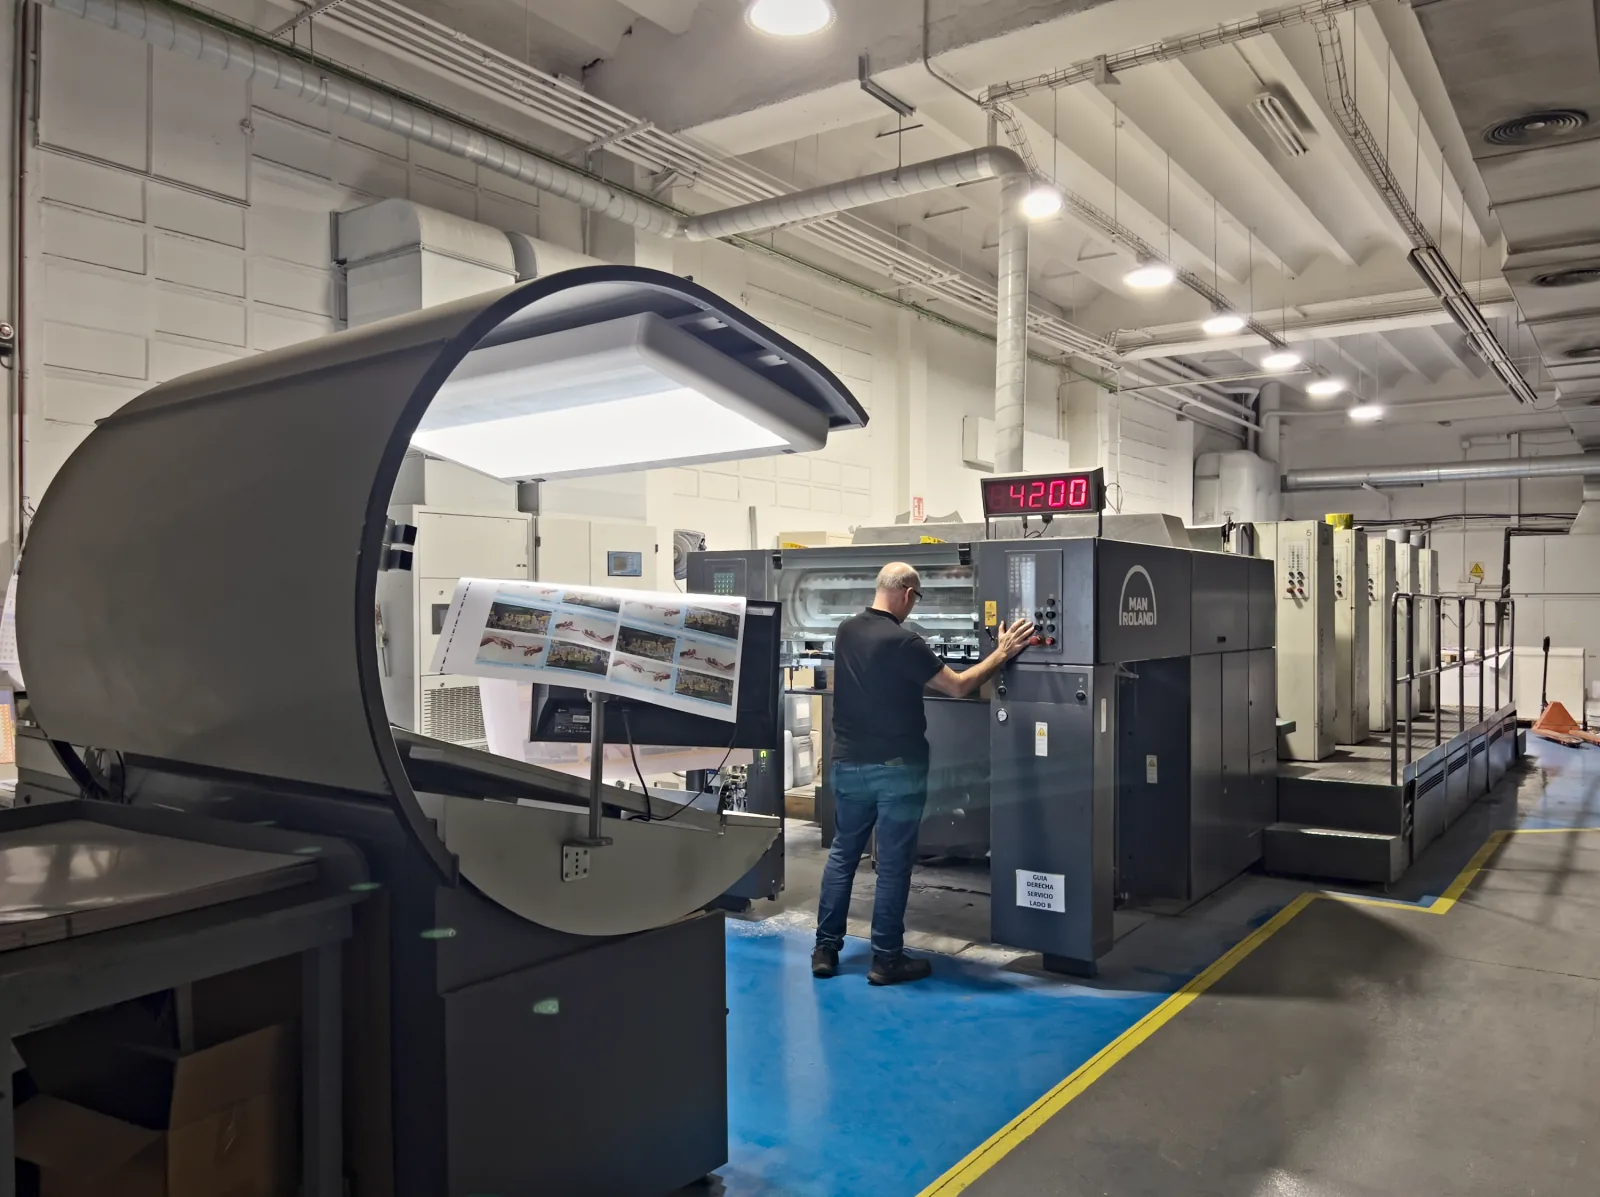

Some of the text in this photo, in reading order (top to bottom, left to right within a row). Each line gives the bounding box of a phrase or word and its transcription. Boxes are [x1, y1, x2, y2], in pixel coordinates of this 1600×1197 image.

[1009, 478, 1087, 508] 4200
[1128, 596, 1148, 611] MAN
[1122, 611, 1154, 626] ROLAND
[1026, 881, 1054, 890] DERECHA
[1027, 890, 1054, 900] SERVICIO
[1029, 900, 1046, 908] LADO
